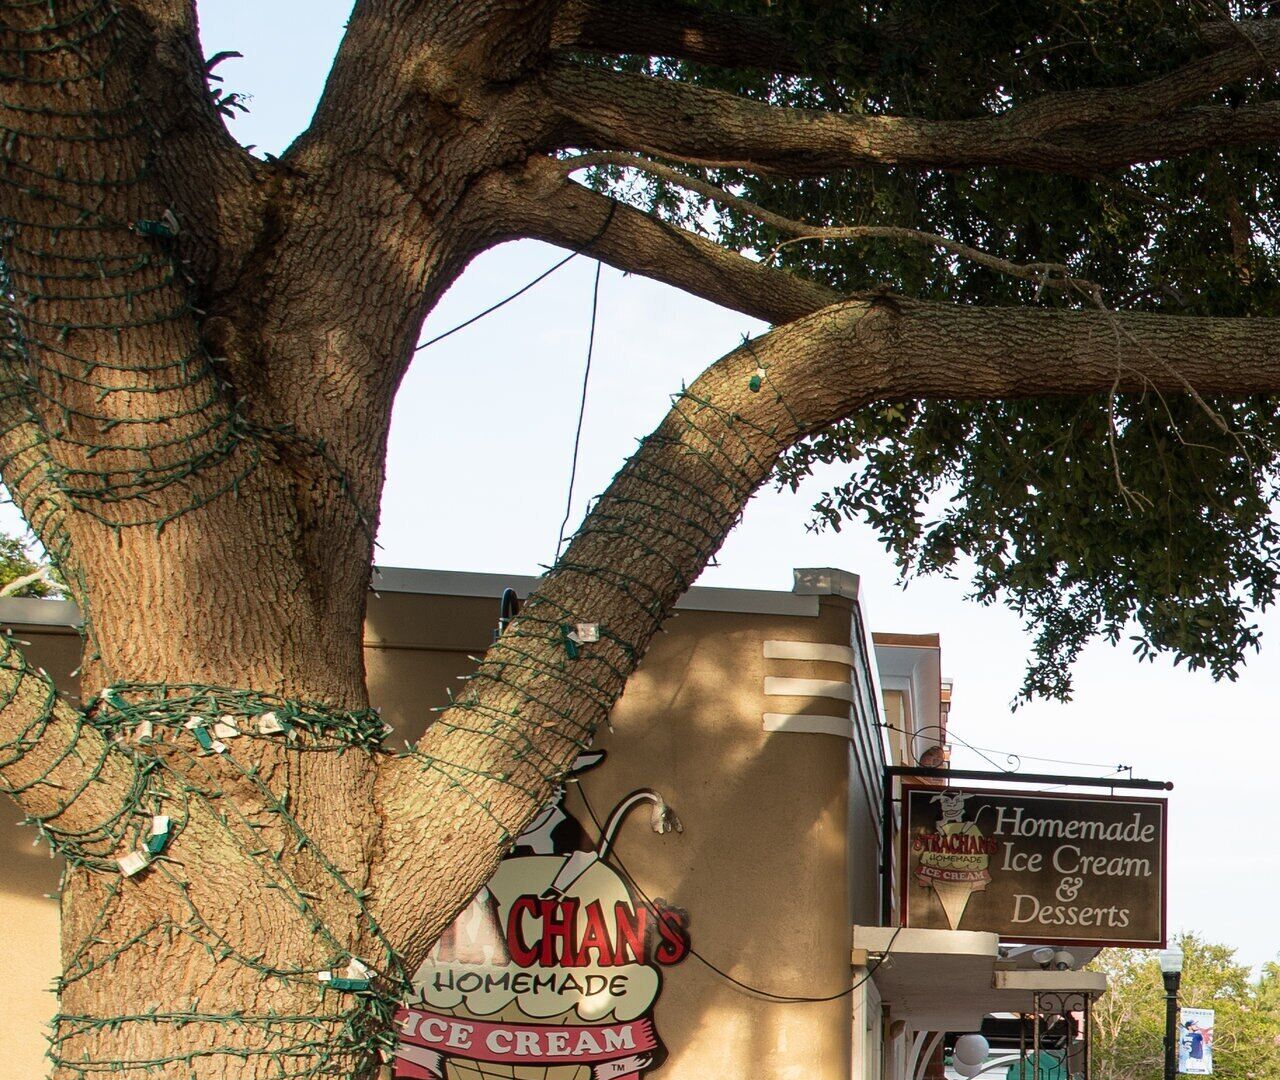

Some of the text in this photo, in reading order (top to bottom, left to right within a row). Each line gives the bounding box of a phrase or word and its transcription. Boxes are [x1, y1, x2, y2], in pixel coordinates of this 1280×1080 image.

[993, 806, 1155, 842] Homemade
[929, 854, 982, 864] HOMEMADE
[1000, 842, 1152, 877] Ice Cream
[920, 866, 985, 880] ICE CREAM
[1055, 876, 1083, 903] &
[1010, 894, 1131, 928] Desserts
[432, 971, 629, 997] HOMEMADE
[400, 1012, 637, 1057] ICE CREAM
[611, 1063, 625, 1072] TM
